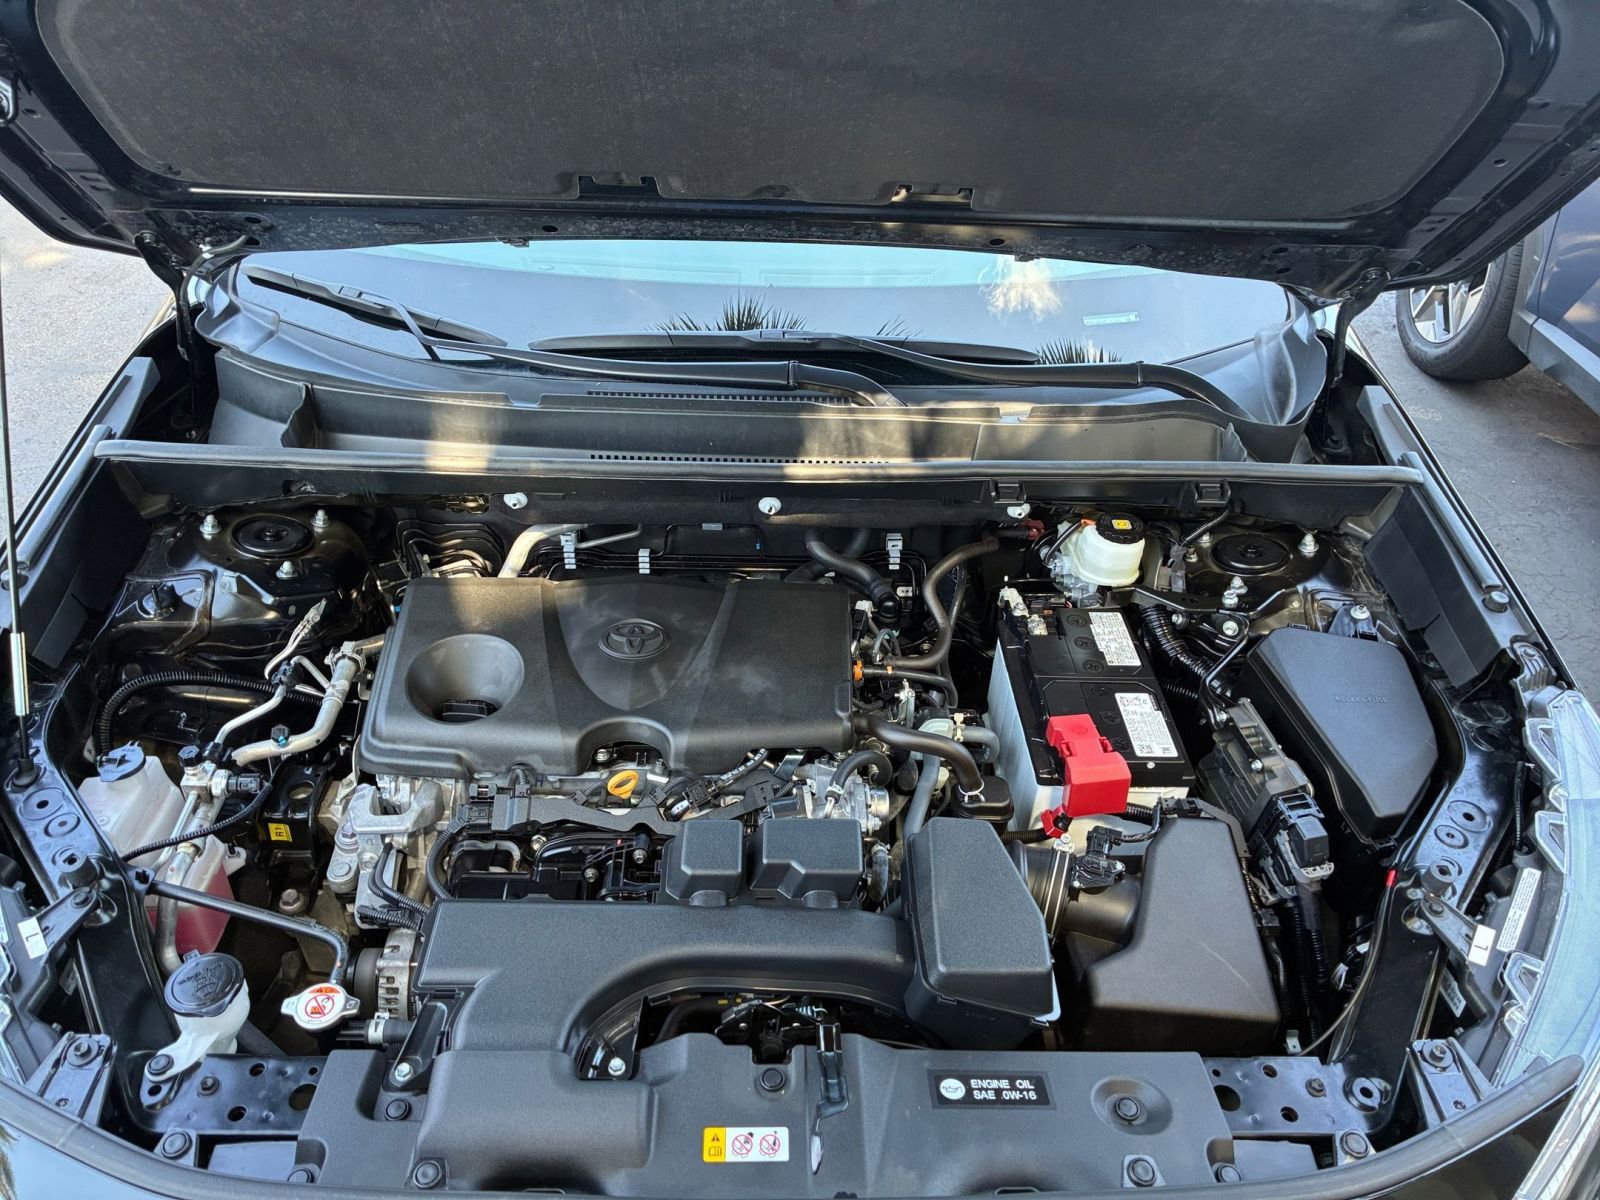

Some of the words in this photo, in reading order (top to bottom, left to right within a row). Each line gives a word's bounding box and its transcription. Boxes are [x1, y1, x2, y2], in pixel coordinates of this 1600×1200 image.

[970, 1079, 1010, 1089] ENGINE
[1016, 1080, 1035, 1089] OIL
[973, 1091, 996, 1100] SAE
[1002, 1091, 1037, 1101] 0W-16
